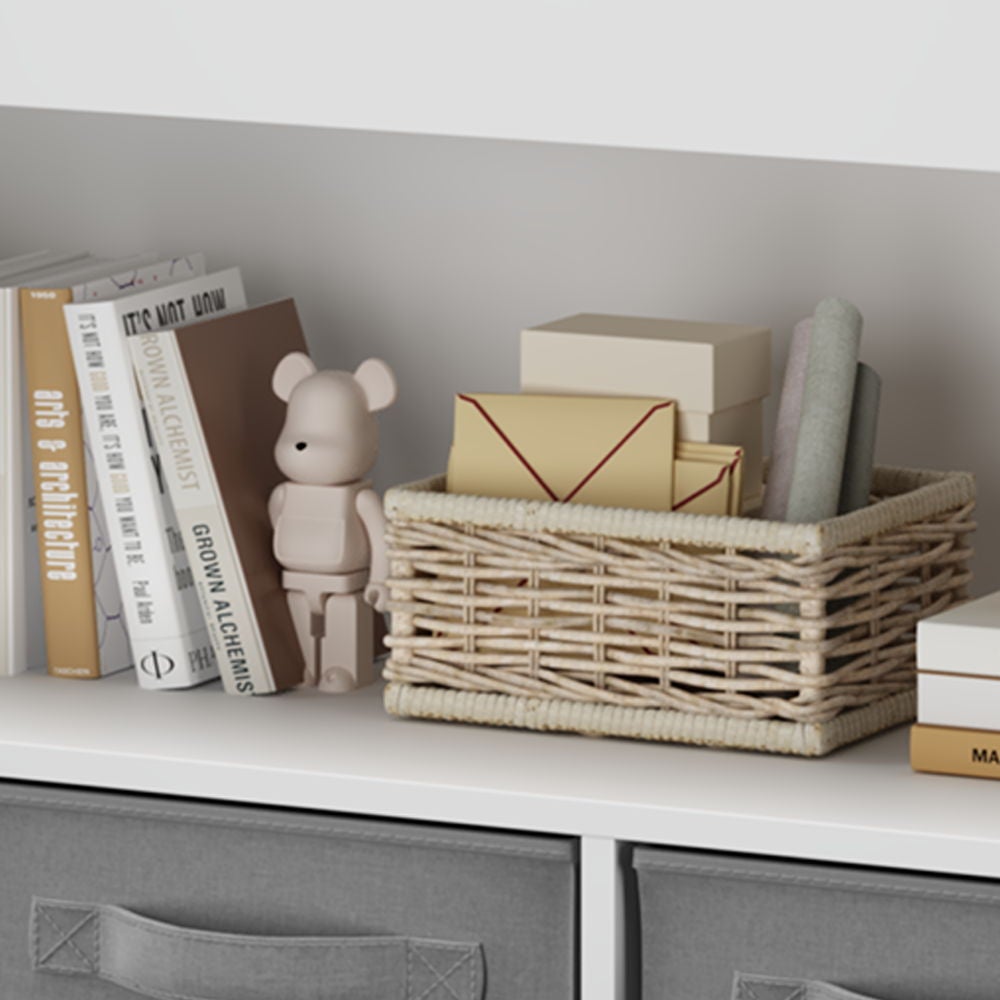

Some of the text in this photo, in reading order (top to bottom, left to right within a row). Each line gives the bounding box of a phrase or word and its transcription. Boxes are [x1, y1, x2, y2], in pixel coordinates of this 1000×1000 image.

[95, 394, 114, 411] YOU
[140, 334, 171, 390] ROWN
[156, 391, 200, 490] ALCHEMIST
[33, 390, 79, 581] arts & architecture
[115, 497, 134, 513] YOU
[119, 516, 140, 538] WANT
[192, 523, 227, 594] GROWN
[213, 598, 255, 695] ALCHEMIS
